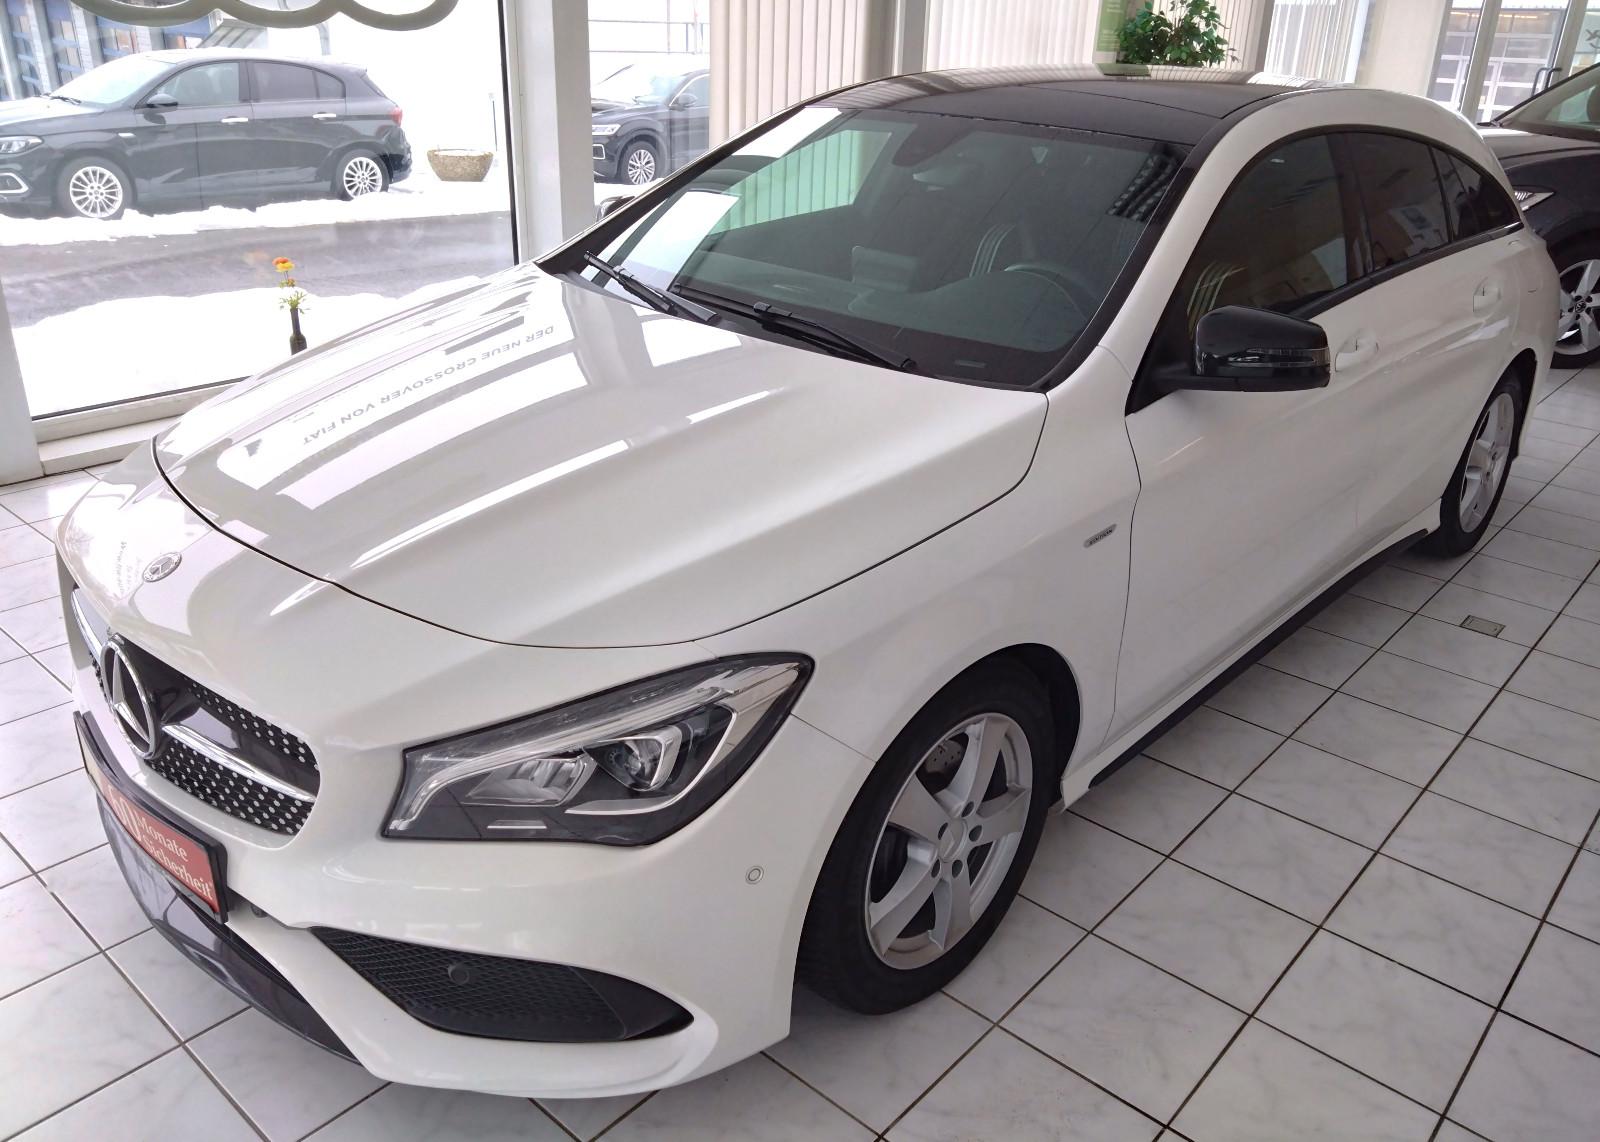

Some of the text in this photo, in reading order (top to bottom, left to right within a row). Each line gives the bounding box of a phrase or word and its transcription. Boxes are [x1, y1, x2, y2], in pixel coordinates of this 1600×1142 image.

[526, 325, 554, 344] DER
[481, 340, 521, 361] NEUE
[380, 357, 477, 404] CROSSOVER
[340, 403, 375, 425] VON
[303, 422, 336, 445] FIAT
[133, 810, 188, 862] Monate
